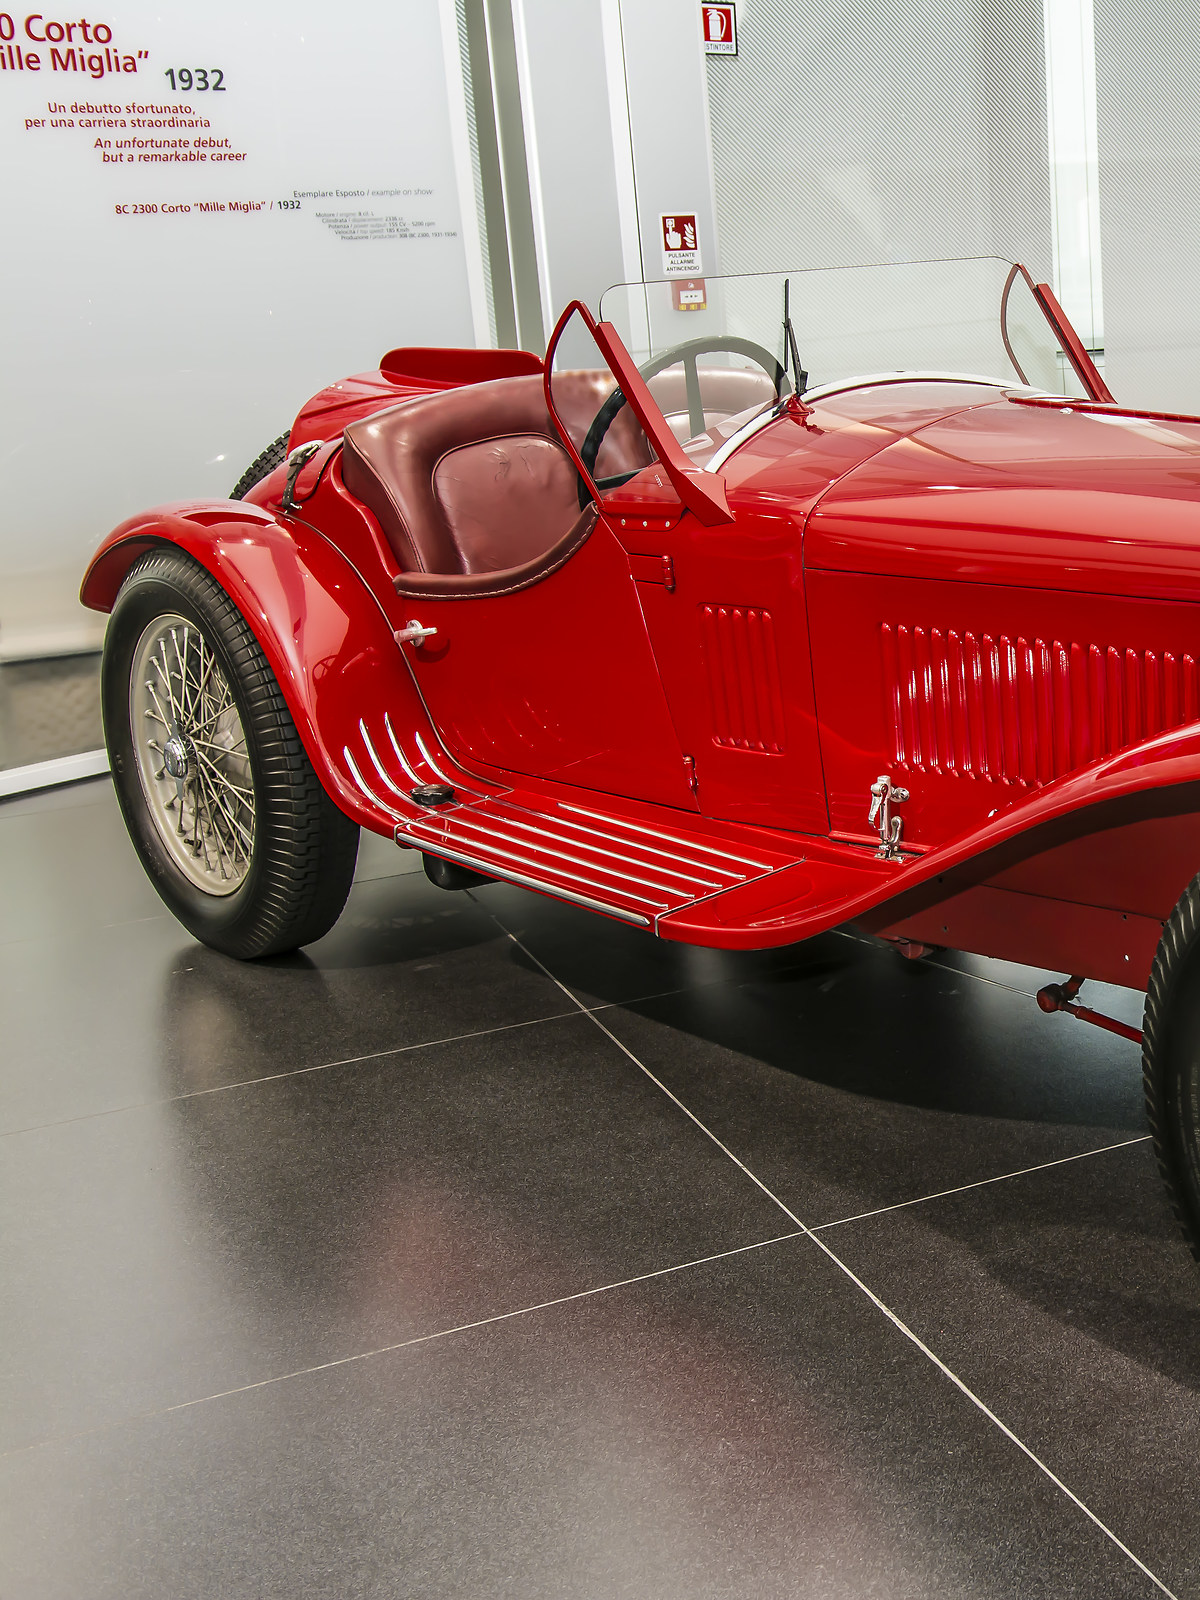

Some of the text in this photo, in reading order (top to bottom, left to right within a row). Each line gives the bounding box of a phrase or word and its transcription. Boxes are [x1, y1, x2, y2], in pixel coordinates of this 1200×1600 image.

[24, 14, 113, 43] Corto
[704, 43, 733, 51] STINTORE
[164, 68, 226, 92] 1932
[48, 102, 196, 115] Un debutto sfortunato,
[25, 117, 211, 130] per una carriera straordinaria
[94, 137, 232, 149] An unfortunate debut,
[102, 151, 247, 163] but a remarkable career
[293, 190, 333, 198] Esemplare
[335, 189, 365, 198] Esposto
[115, 204, 129, 214] 8C
[132, 204, 158, 214] 2300
[161, 203, 191, 213] Corto
[277, 200, 301, 210] 1932
